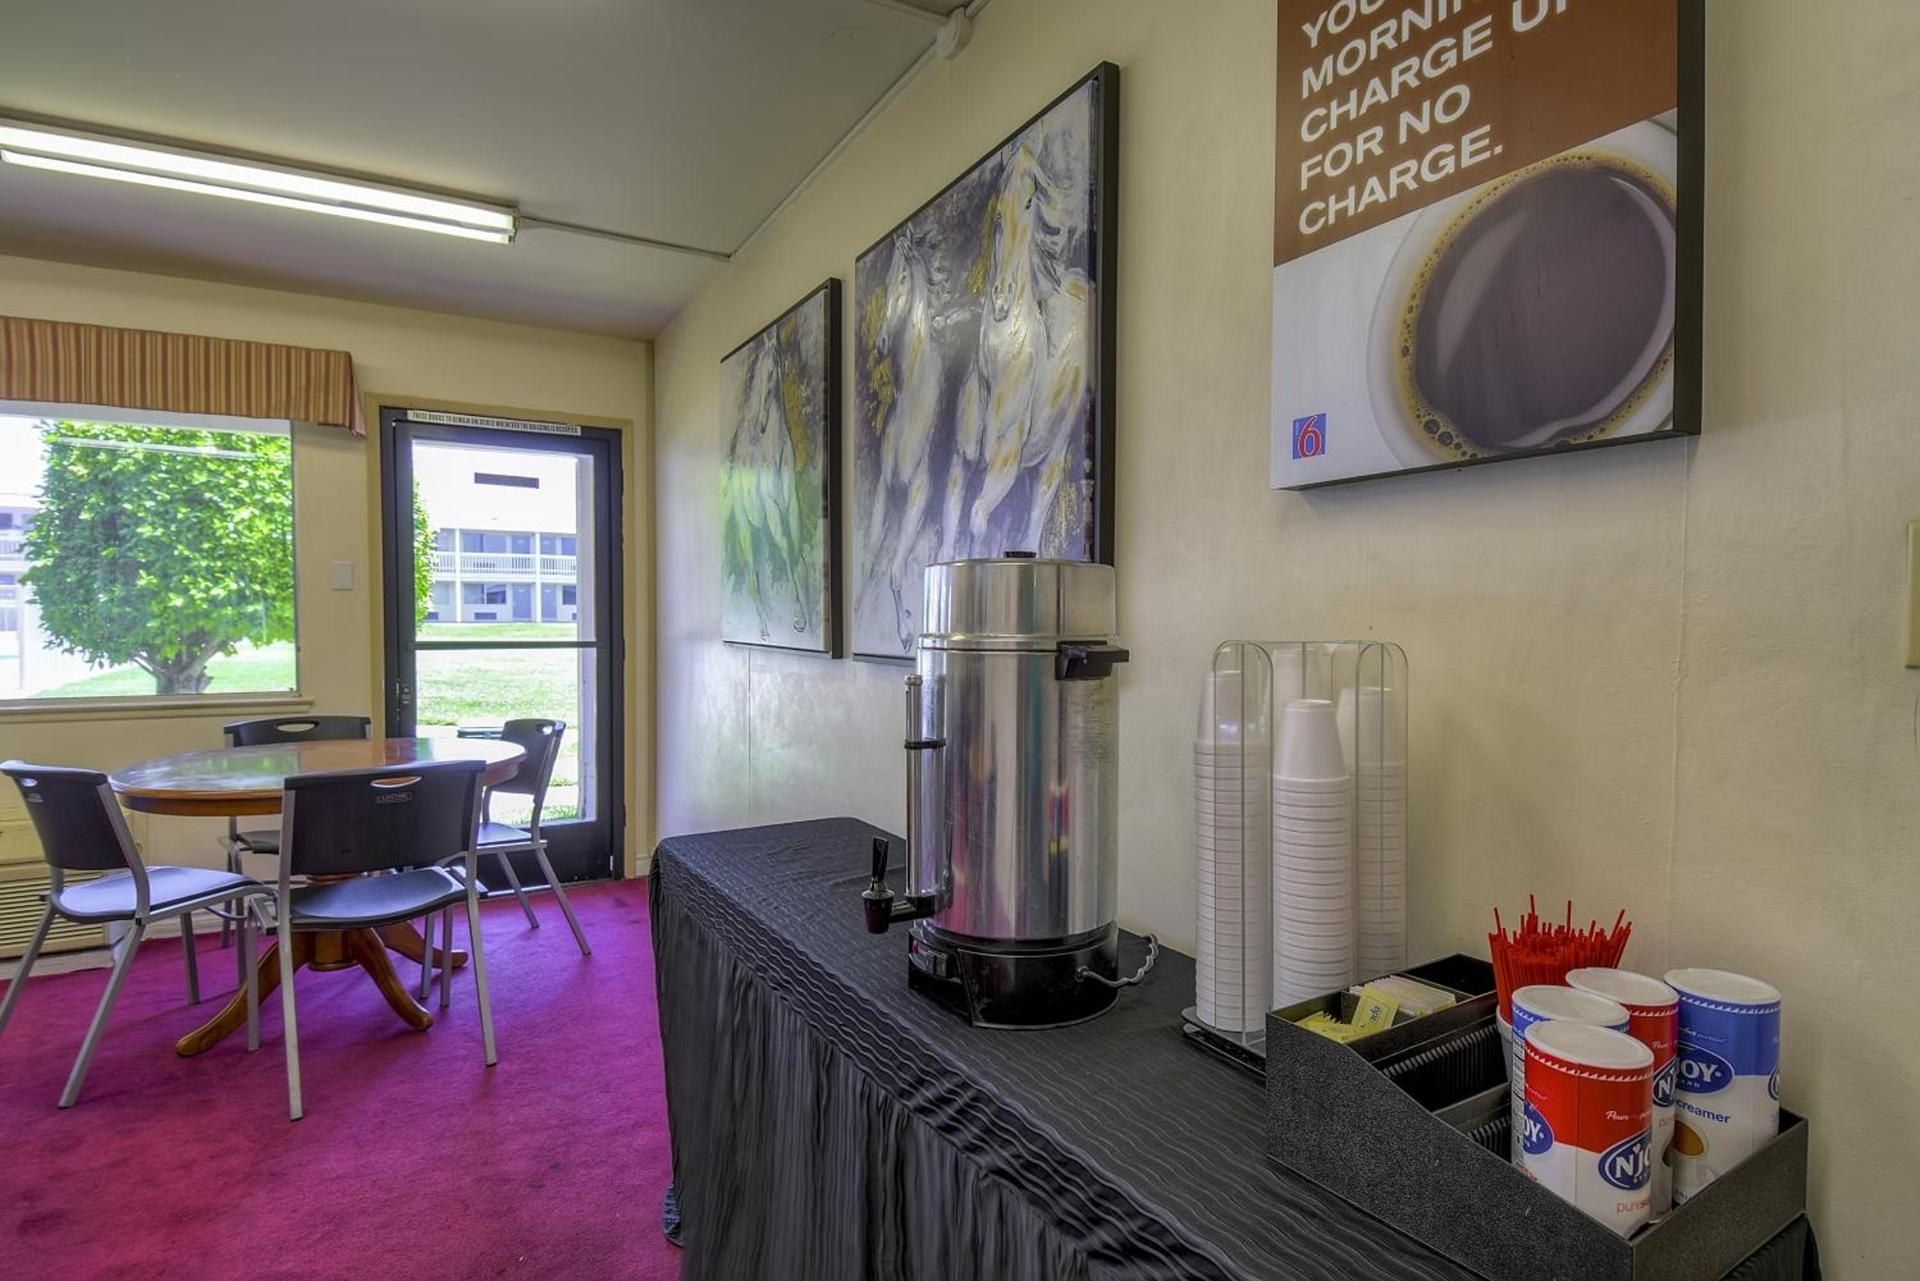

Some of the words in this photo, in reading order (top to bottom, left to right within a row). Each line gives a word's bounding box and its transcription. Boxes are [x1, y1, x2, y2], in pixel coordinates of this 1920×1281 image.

[1301, 14, 1494, 143] CHARGE
[1301, 125, 1384, 192] FOR
[1399, 84, 1471, 145] NO
[1299, 124, 1503, 235] CHARGE.
[1298, 415, 1322, 458] 6
[1680, 1059, 1719, 1082] OY
[1676, 1099, 1732, 1124] creamer
